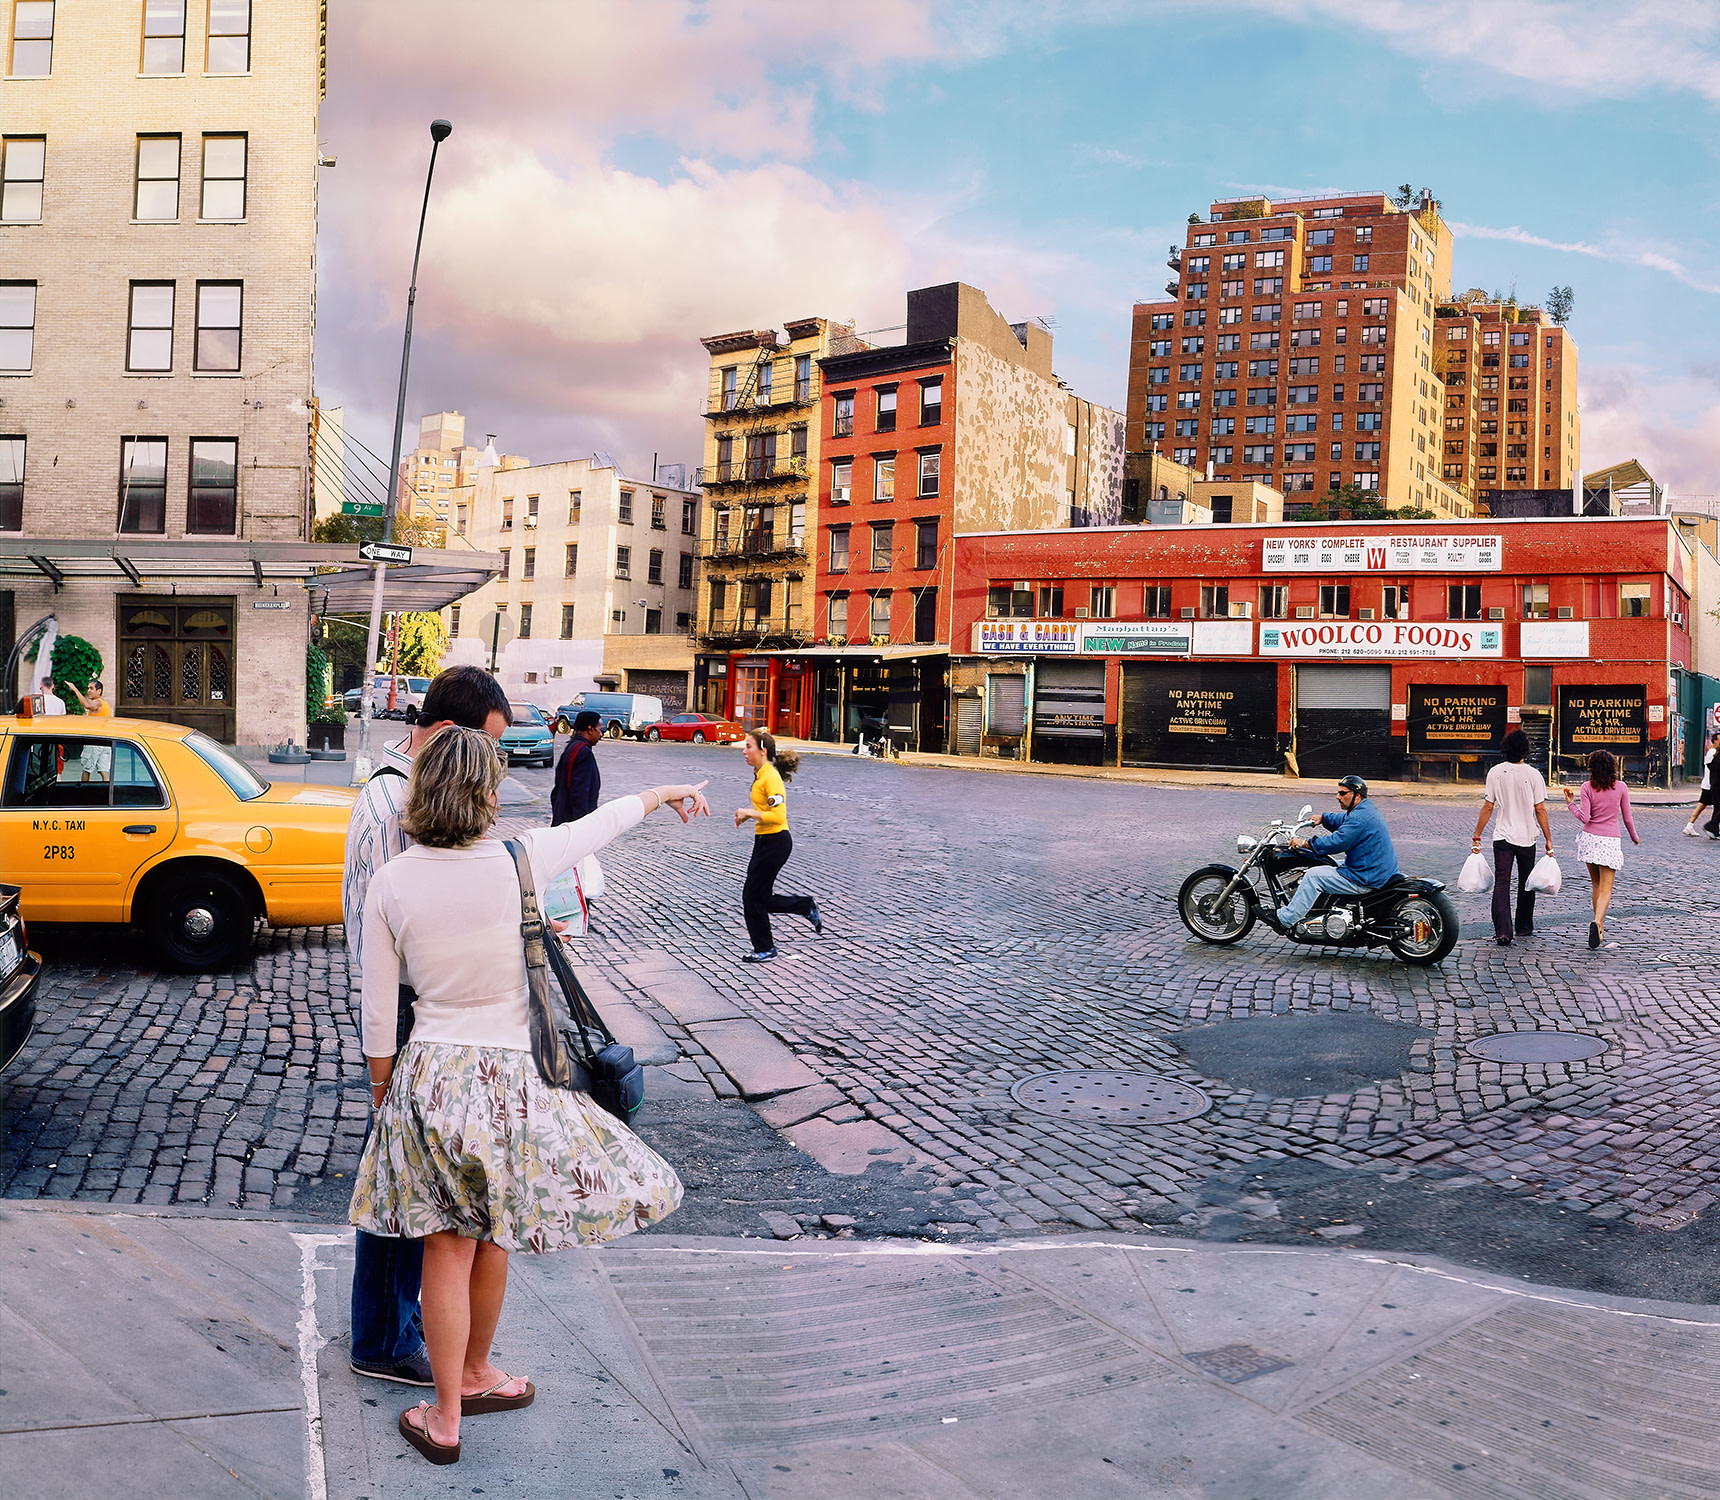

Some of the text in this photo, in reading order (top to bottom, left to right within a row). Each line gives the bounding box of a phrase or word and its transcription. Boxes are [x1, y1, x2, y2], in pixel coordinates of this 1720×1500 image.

[353, 504, 361, 514] 9
[1266, 538, 1497, 549] NEW YORKS' COMPLETE RESTAURANT SUPPLIER
[366, 547, 406, 559] ONE WAY
[1345, 553, 1360, 563] CHEESE
[1367, 548, 1386, 569] W
[982, 624, 1077, 641] CASH & CARRY
[1096, 625, 1179, 633] Manhattan's
[1281, 625, 1473, 652] WOOLCO FOODS
[1023, 643, 1075, 651] EVERYTHING
[1085, 638, 1125, 651] NEW
[1127, 640, 1148, 650] Name
[649, 684, 689, 694] PARKING
[1168, 690, 1234, 700] NO PARKING
[1176, 700, 1223, 709] ANYTIME
[1424, 697, 1497, 706] NO PARKING
[1568, 699, 1642, 708] NO PARKING
[1431, 707, 1483, 715] ANYTIME
[1579, 709, 1631, 718] ANYTIME
[1459, 715, 1476, 723] HR.
[1590, 718, 1623, 726] 24 HR.
[1455, 723, 1491, 731] DRIVEWAY
[1574, 726, 1641, 735] ACTIVE DRIVEWAY
[32, 820, 86, 831] N.Y.C. TAXI
[44, 844, 75, 860] 2P83
